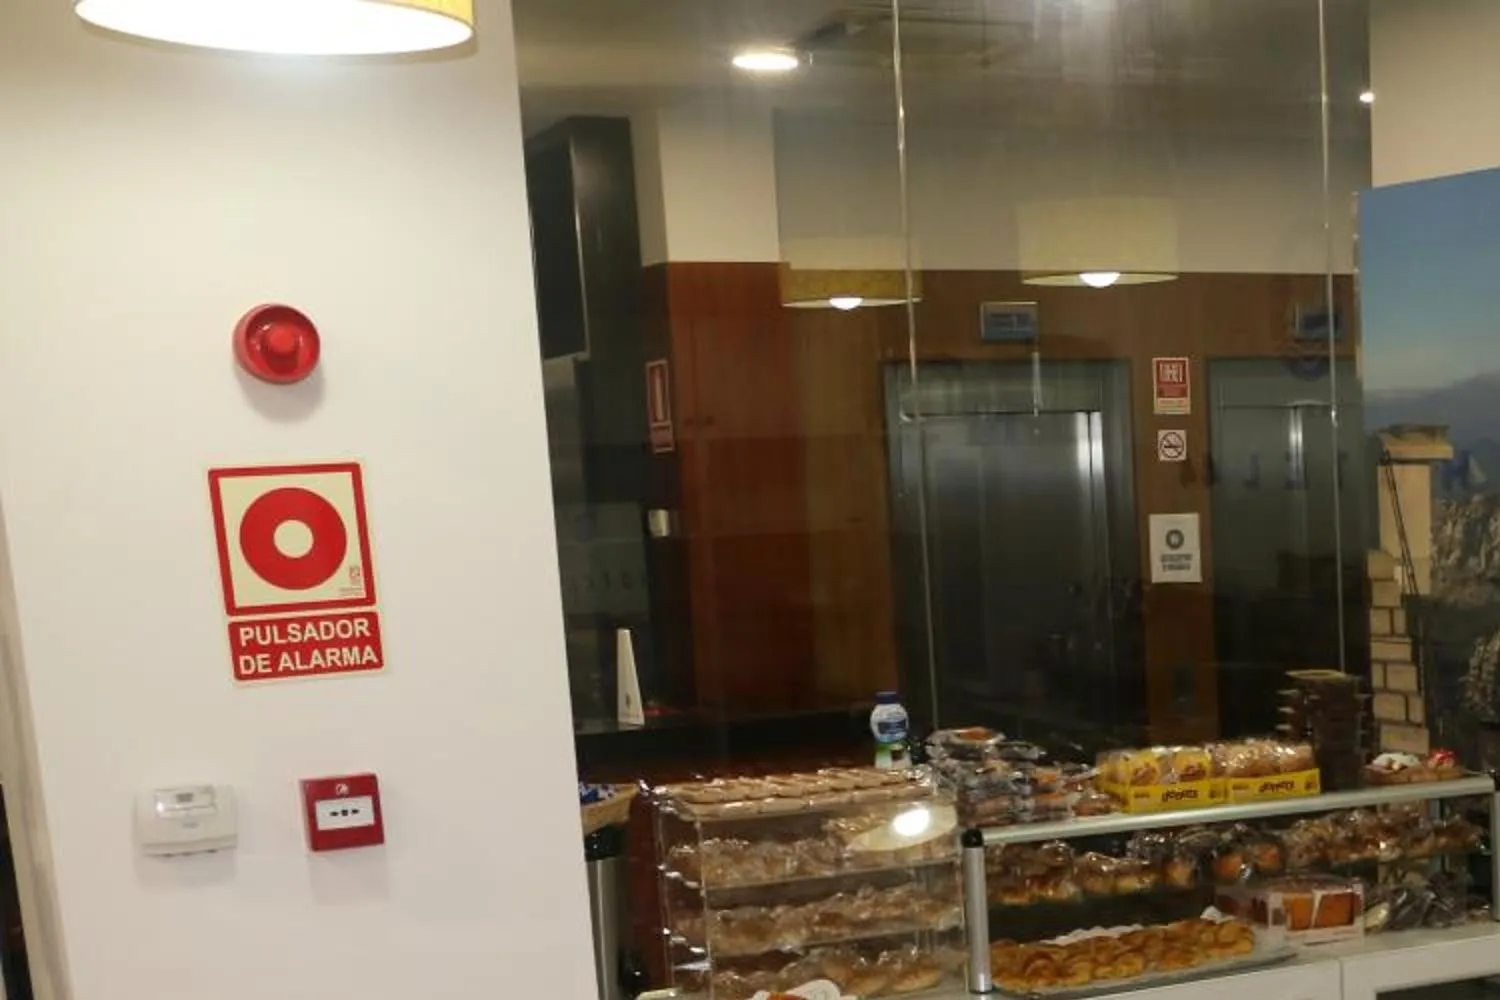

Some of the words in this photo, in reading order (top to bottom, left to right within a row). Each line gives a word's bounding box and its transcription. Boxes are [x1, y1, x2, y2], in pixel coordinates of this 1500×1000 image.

[239, 618, 371, 646] PULSADOR
[239, 653, 272, 675] DE
[278, 646, 378, 671] ALARMA
